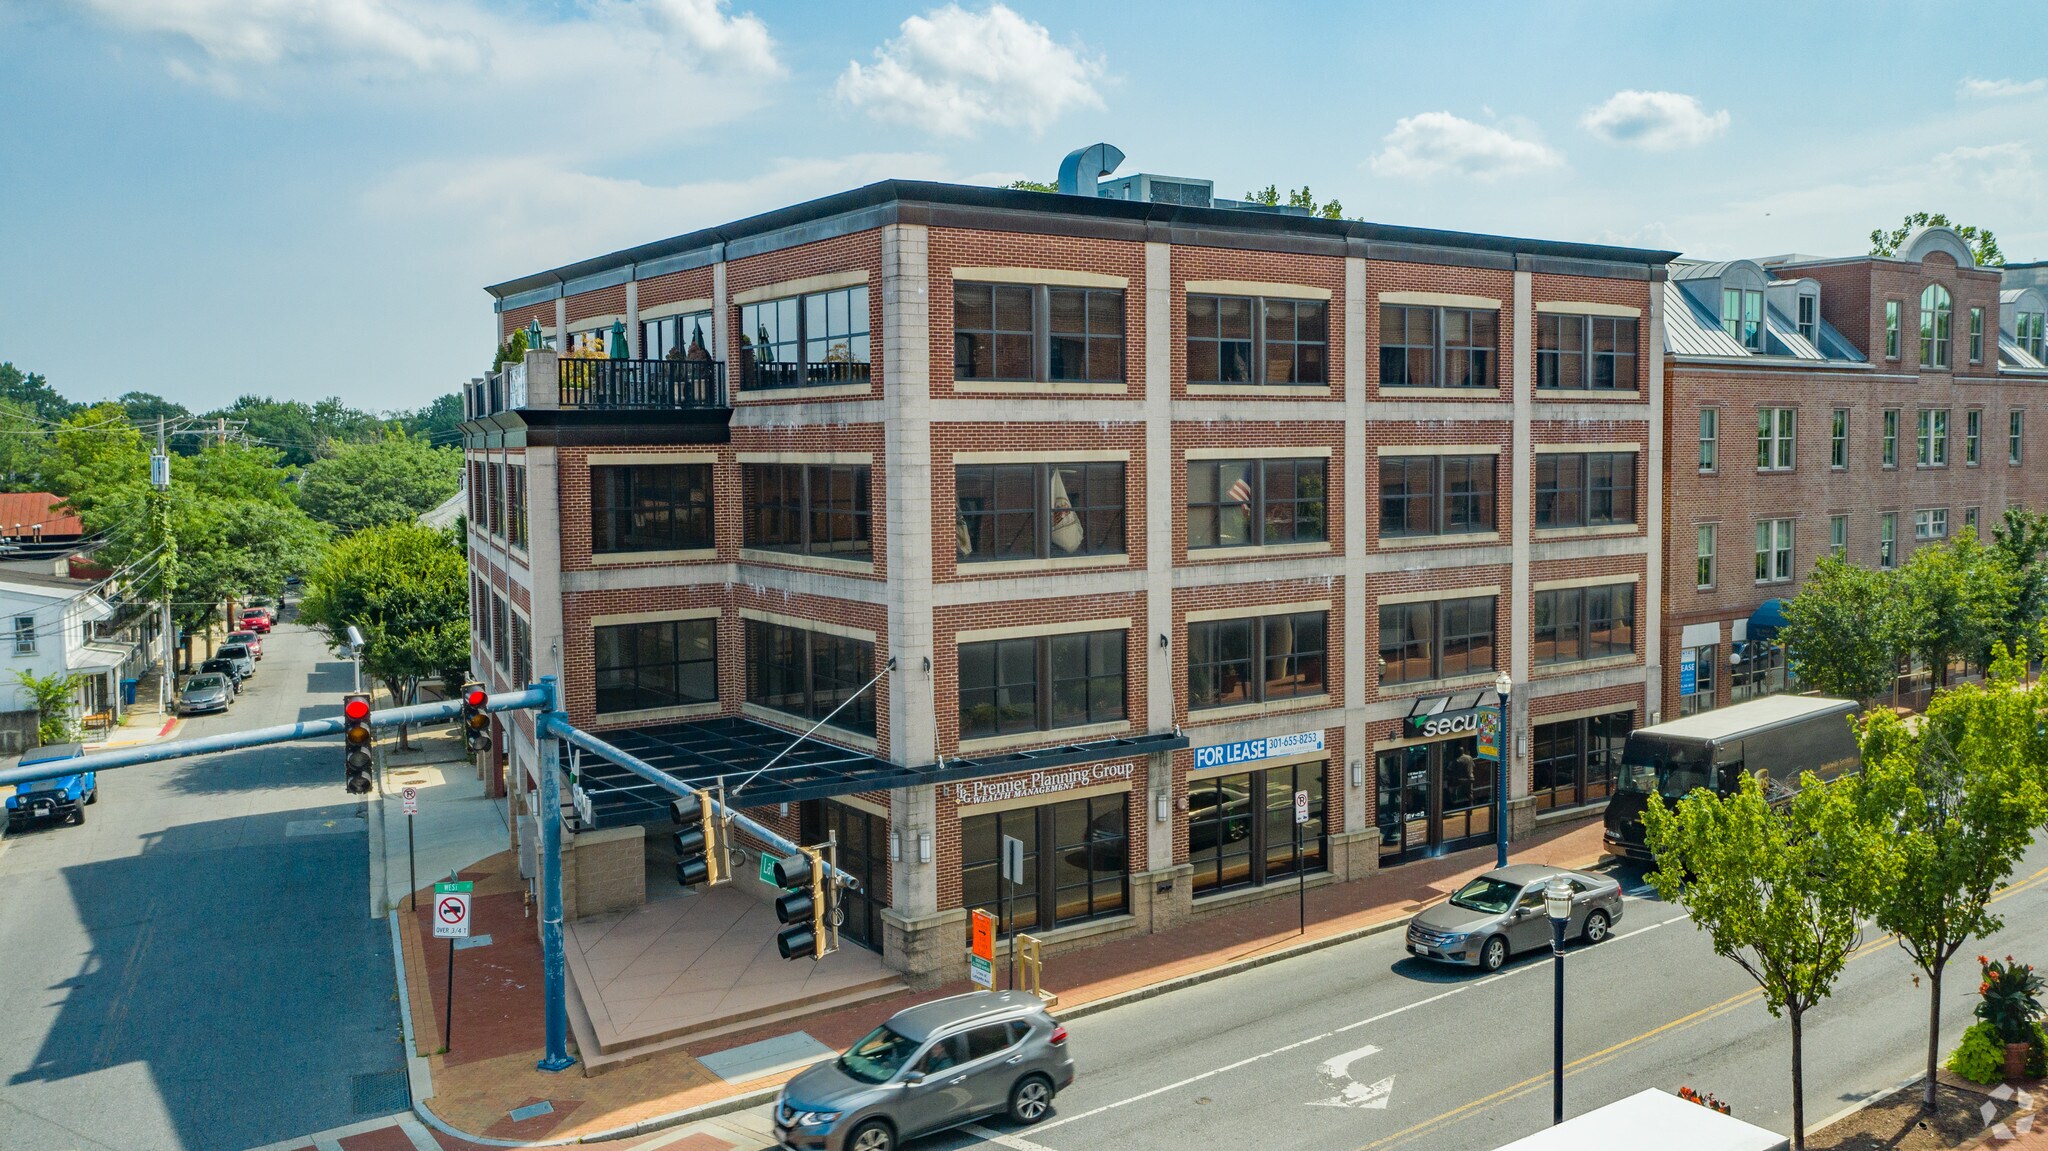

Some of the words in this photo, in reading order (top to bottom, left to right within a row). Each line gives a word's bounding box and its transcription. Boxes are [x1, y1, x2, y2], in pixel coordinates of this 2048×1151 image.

[1423, 714, 1478, 737] secu
[1197, 746, 1224, 767] FOR
[1227, 740, 1266, 763] LEASE
[973, 777, 1028, 797] Premier
[1031, 768, 1090, 786] Planning
[1092, 763, 1134, 779] Group
[973, 790, 1012, 804] WEALTH
[1013, 782, 1075, 798] MANAGEMENT
[443, 883, 458, 891] WEST
